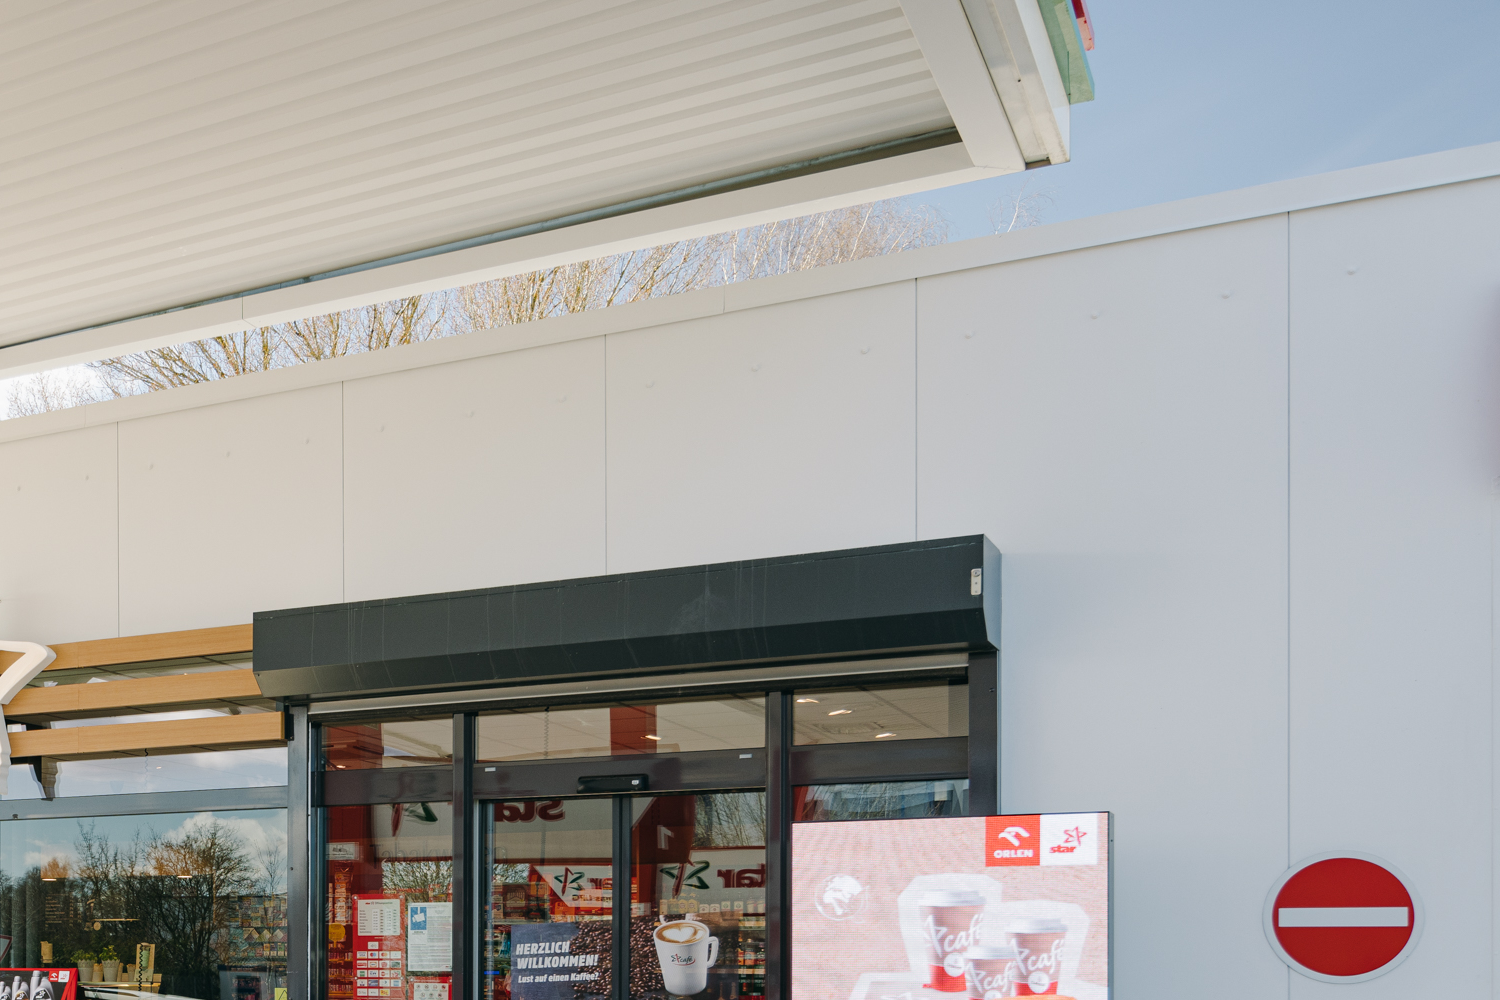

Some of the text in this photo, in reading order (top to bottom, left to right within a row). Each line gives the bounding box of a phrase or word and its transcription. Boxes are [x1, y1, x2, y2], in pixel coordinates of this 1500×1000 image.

[993, 849, 1034, 859] ORLEN
[1049, 844, 1077, 854] star
[515, 939, 571, 956] HERZLICH
[516, 954, 599, 970] WILLKOMMEN!
[518, 971, 600, 984] Lust auf einen Kaffee?
